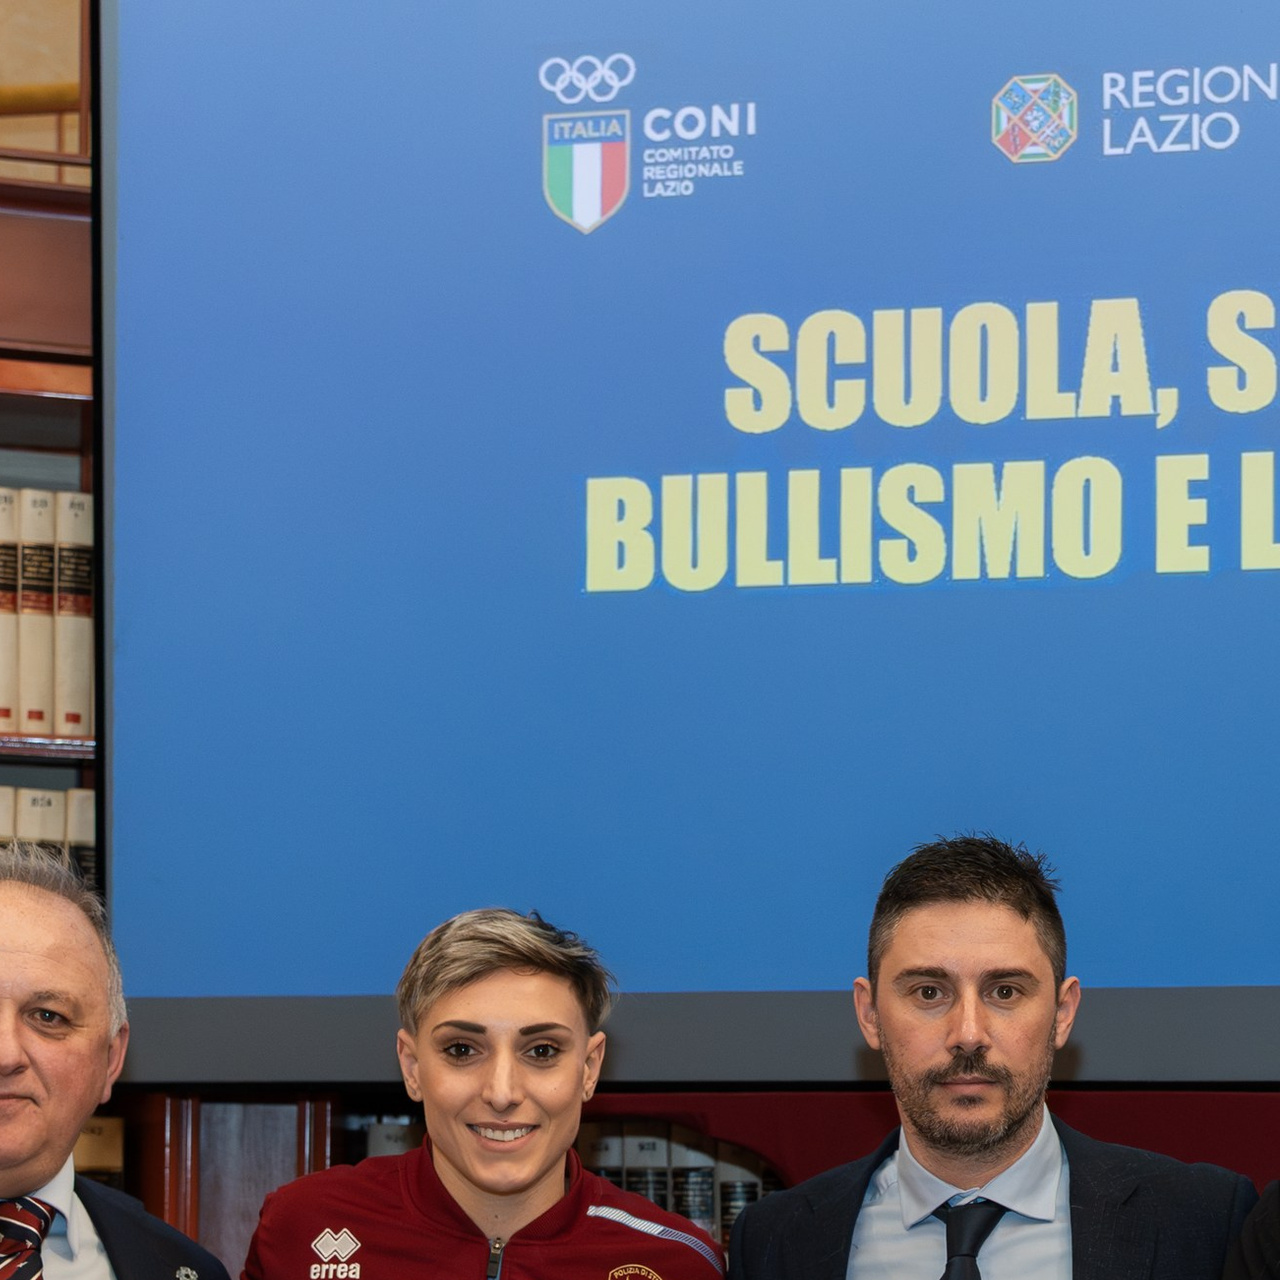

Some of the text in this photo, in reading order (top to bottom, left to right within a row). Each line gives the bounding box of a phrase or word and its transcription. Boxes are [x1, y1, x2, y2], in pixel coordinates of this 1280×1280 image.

[553, 119, 623, 140] ITALIA
[643, 102, 757, 142] CONI
[1103, 111, 1241, 156] LAZIO
[643, 145, 735, 163] COMITATO
[643, 161, 744, 180] REGIONALE
[643, 180, 694, 198] LAZIO
[723, 297, 1180, 434] SCUOLA,
[585, 455, 1123, 592] BULLISMO
[1155, 453, 1211, 574] E
[310, 1263, 361, 1280] errea
[613, 1267, 640, 1280] POLIZIA
